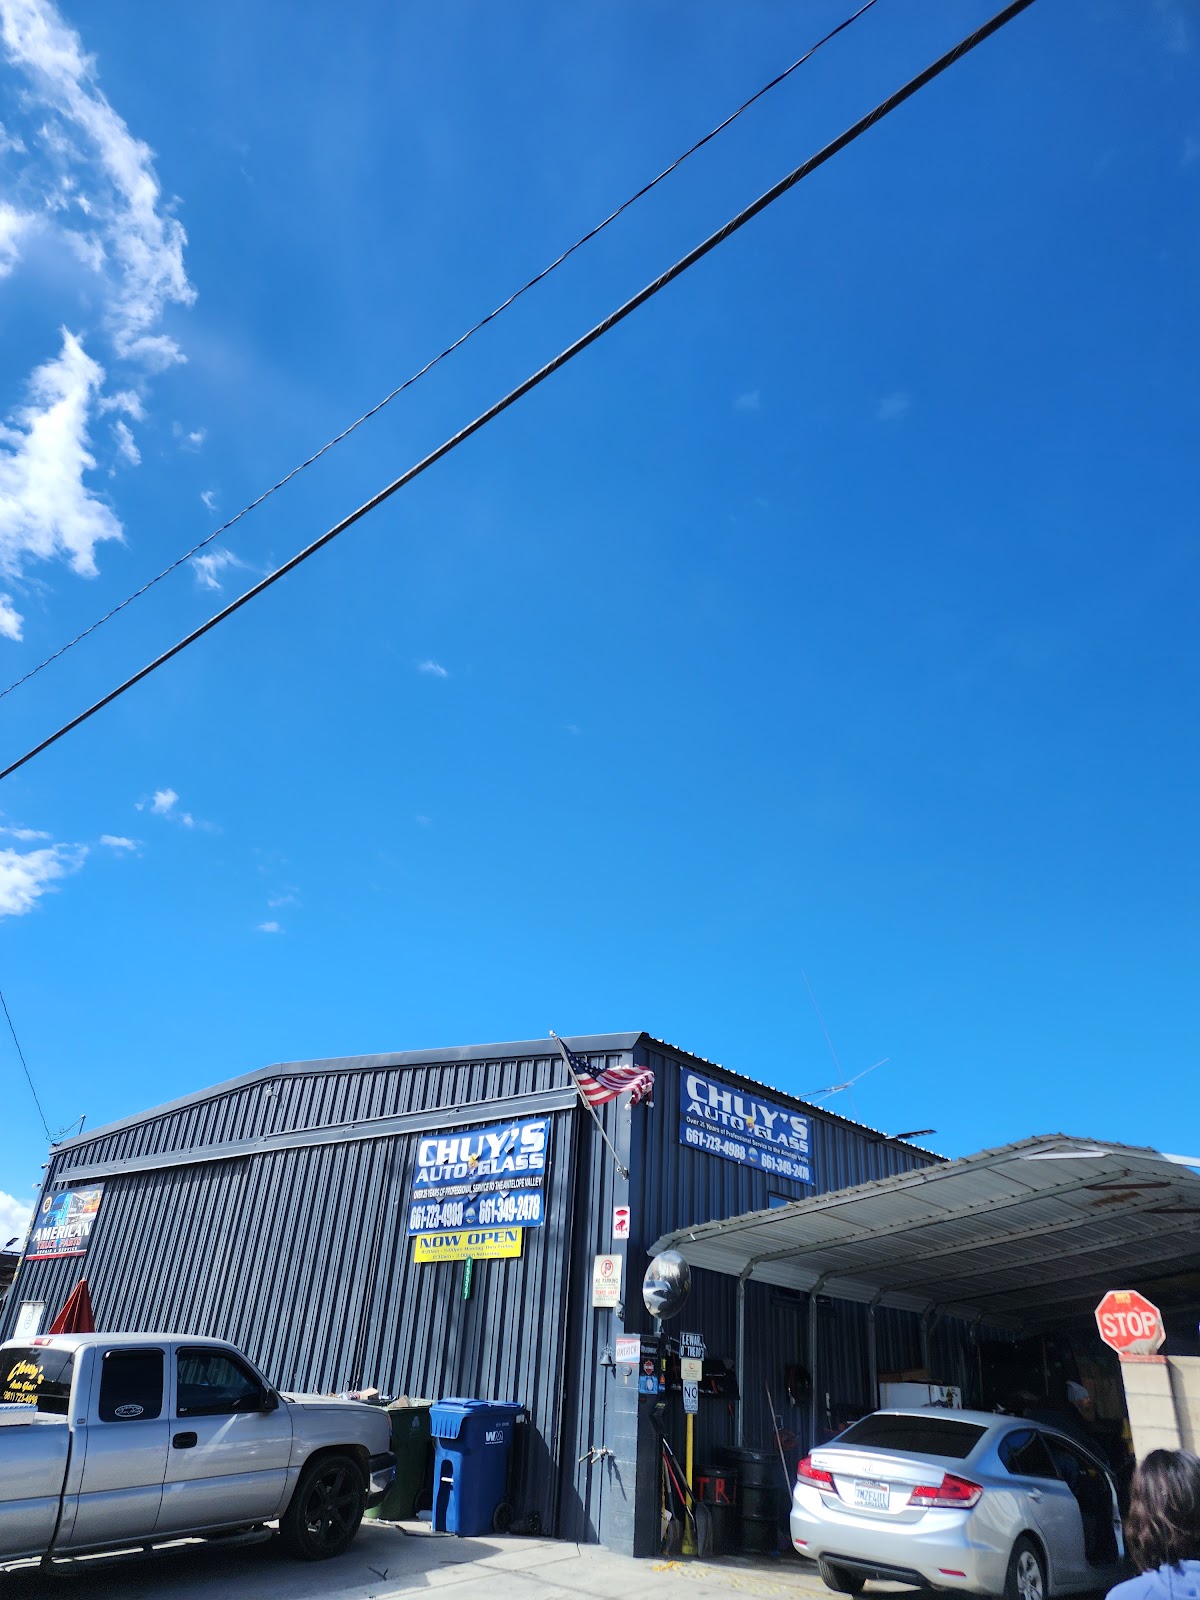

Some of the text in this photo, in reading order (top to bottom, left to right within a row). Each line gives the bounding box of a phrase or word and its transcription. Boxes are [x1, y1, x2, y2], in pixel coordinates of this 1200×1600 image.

[686, 1074, 808, 1140] CHUY'S
[686, 1115, 699, 1126] Over
[706, 1123, 720, 1134] Years
[687, 1101, 809, 1154] AUTO GLASS
[418, 1121, 546, 1168] CHUY'S
[686, 1127, 746, 1160] 661-723-4988
[416, 1153, 544, 1183] AUTO GLASS
[525, 1176, 542, 1187] VALLEY
[410, 1194, 540, 1230] 661-723-4988 661-349-2478
[32, 1221, 93, 1242] AMERICAN
[420, 1230, 518, 1249] NOW OPEN
[1102, 1311, 1157, 1337] STOP
[684, 1387, 698, 1398] NO
